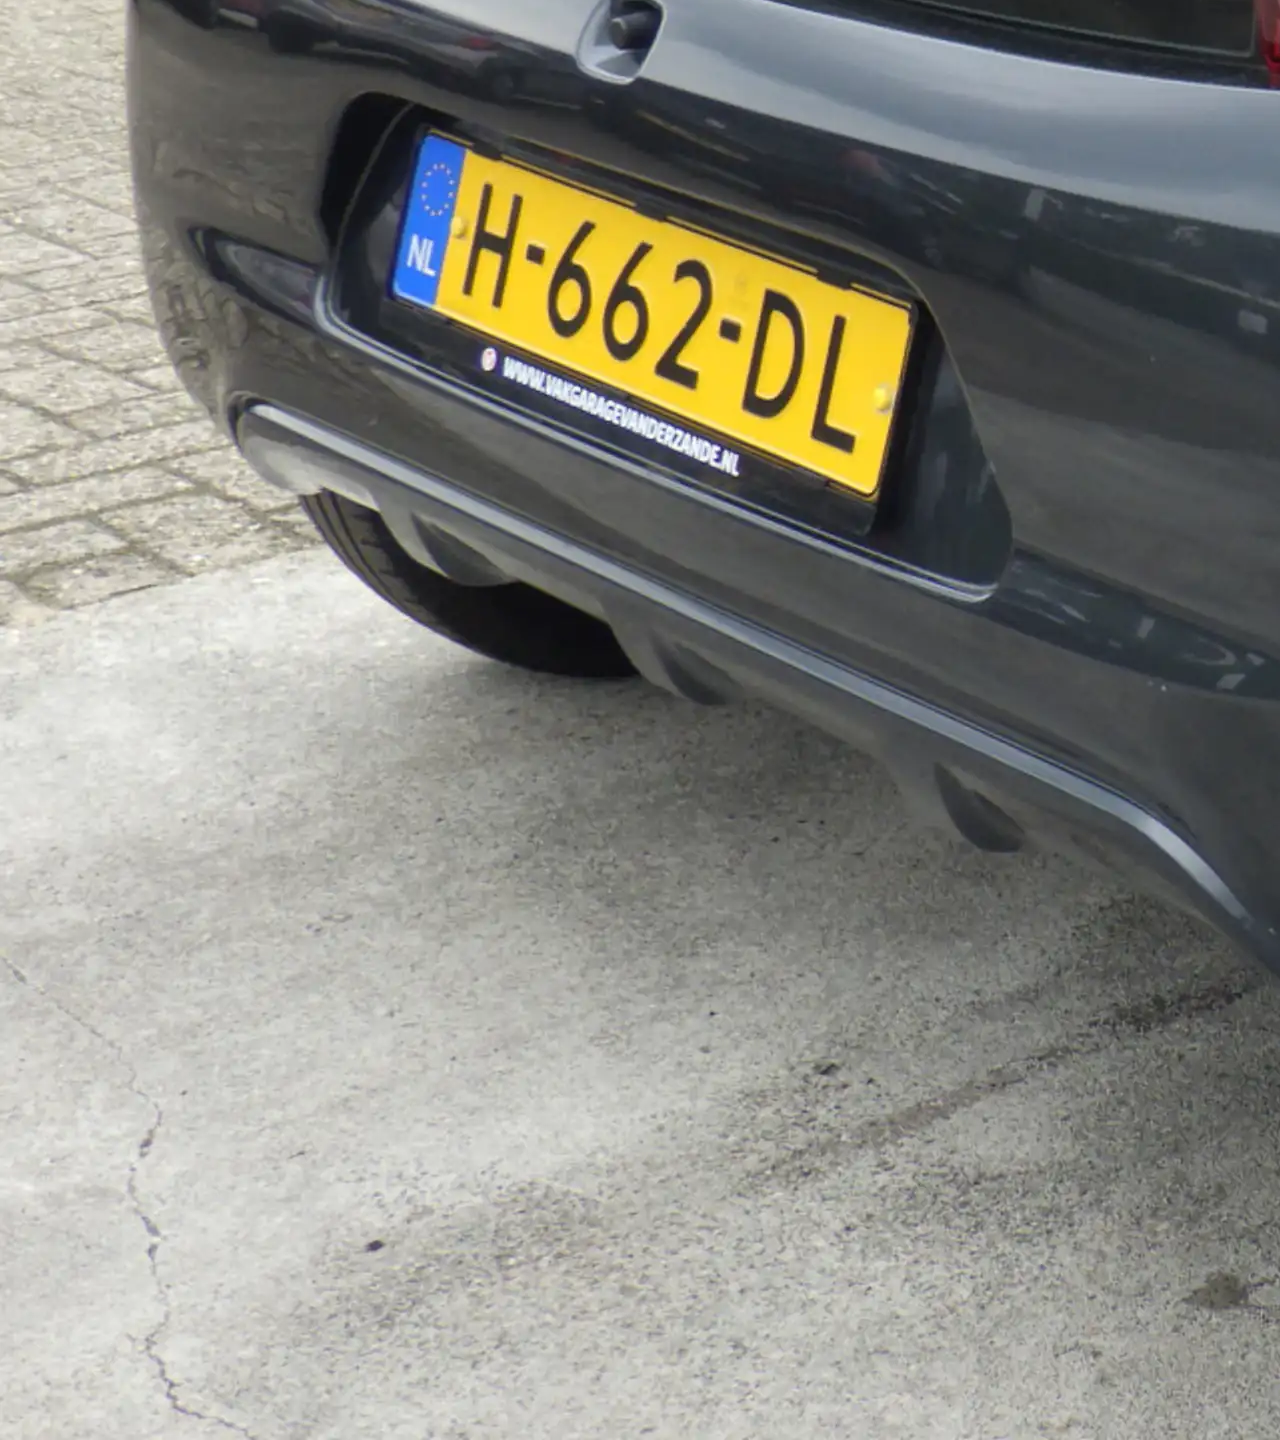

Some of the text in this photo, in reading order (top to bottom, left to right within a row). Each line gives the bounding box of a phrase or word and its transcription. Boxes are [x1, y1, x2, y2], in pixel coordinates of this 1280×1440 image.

[406, 234, 436, 278] NL
[461, 183, 857, 454] H-662-DL
[503, 356, 740, 477] WWW.VAKGARAGEVANDERZANDE.NL
